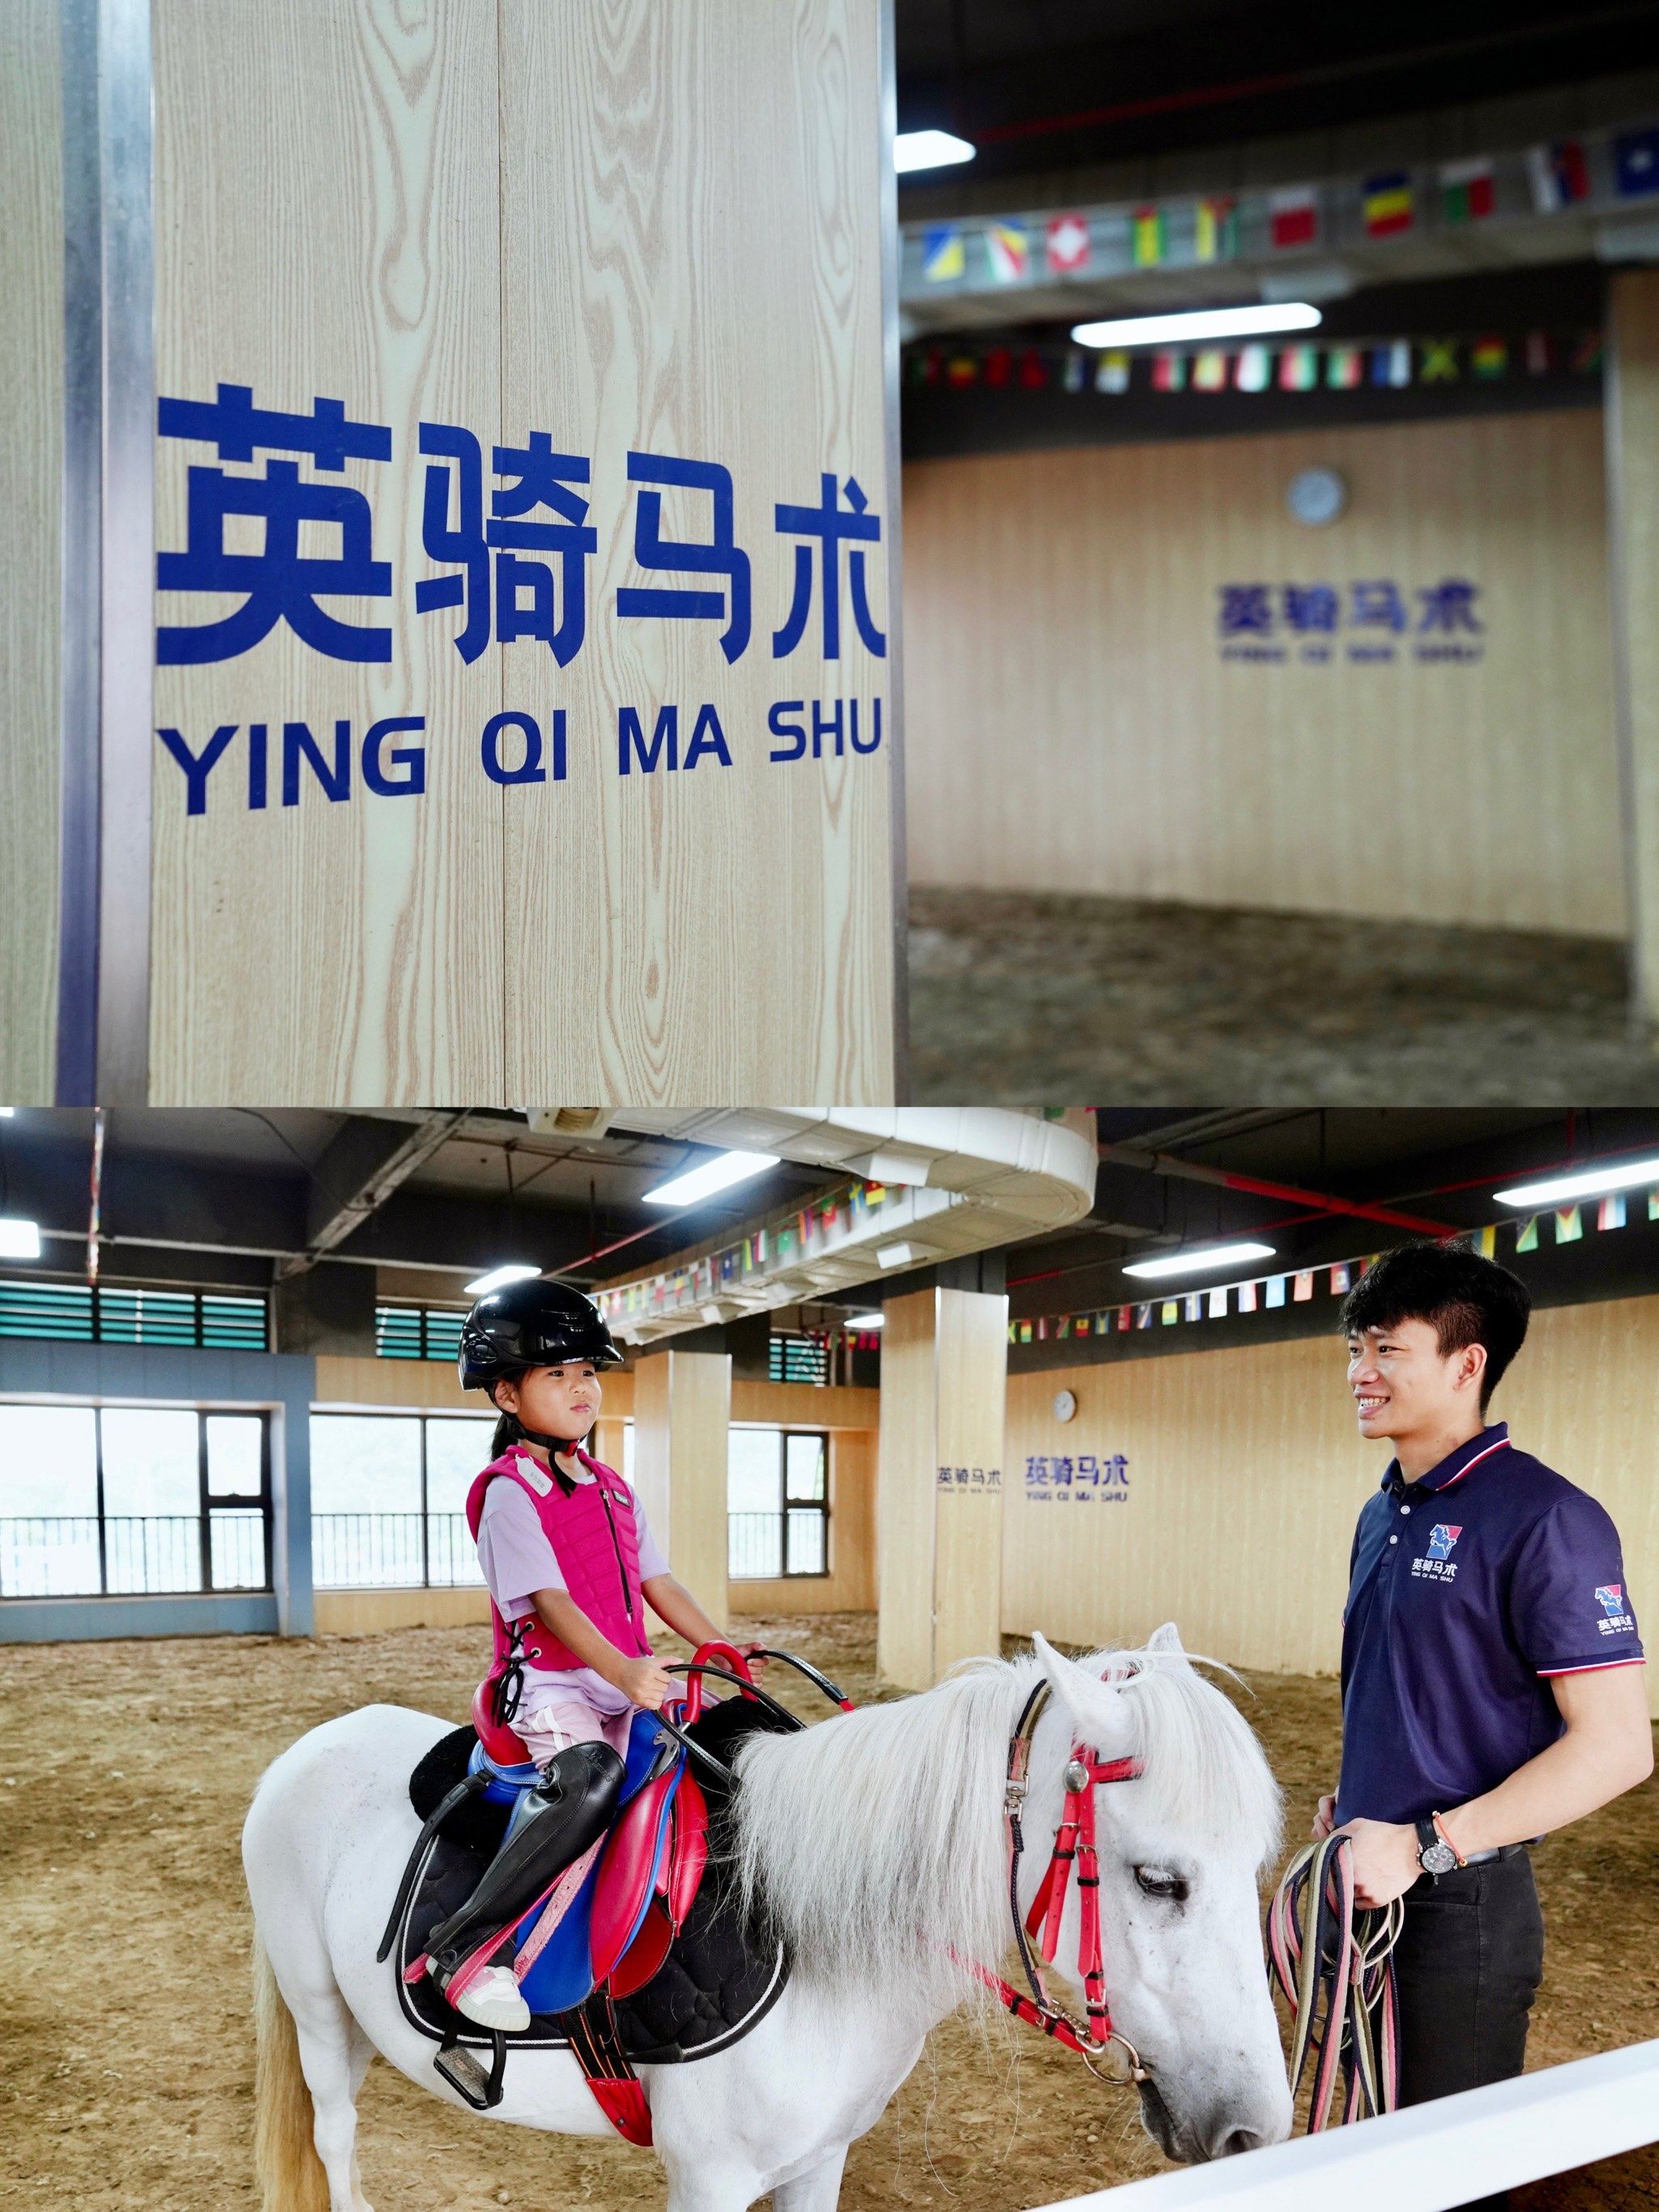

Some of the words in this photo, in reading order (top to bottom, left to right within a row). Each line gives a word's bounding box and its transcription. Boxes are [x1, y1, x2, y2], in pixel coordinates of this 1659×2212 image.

[155, 382, 887, 668] 英骑马术
[156, 716, 426, 817] YING
[480, 709, 568, 786] QI
[618, 704, 733, 776] MA
[768, 697, 883, 762] SHU
[937, 1467, 1001, 1486] 英骑马术
[1024, 1454, 1129, 1486] 英骑马术
[1411, 1557, 1458, 1577] 英骑马术
[1439, 1575, 1453, 1583] SHU
